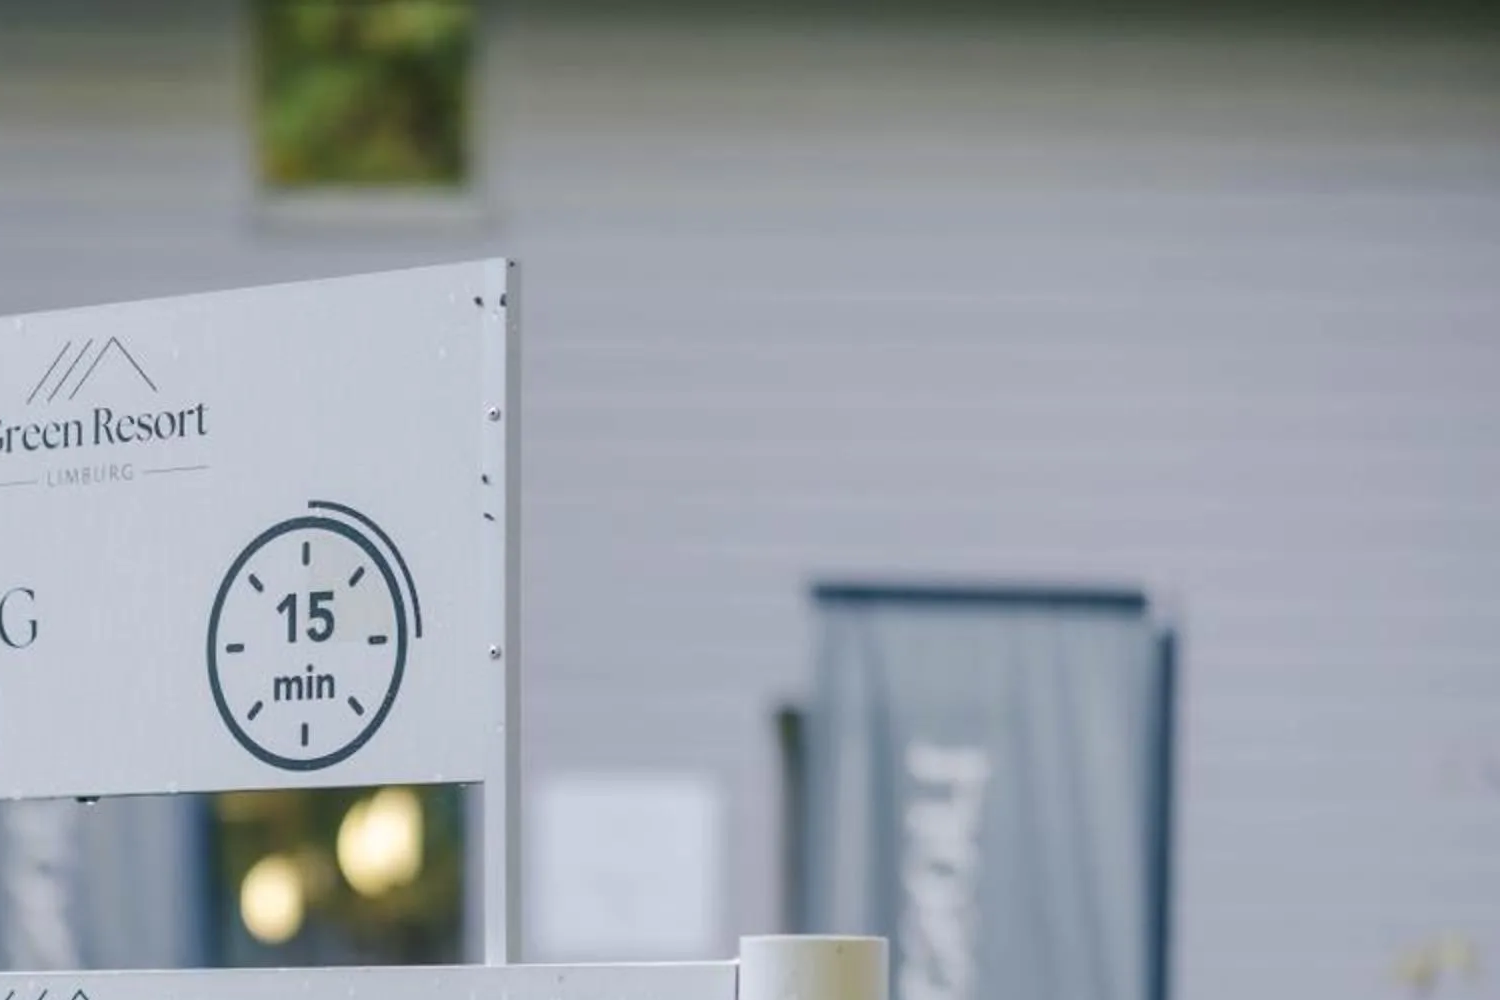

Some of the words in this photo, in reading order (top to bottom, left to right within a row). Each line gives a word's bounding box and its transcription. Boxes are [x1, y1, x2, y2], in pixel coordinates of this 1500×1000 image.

[92, 402, 209, 445] Resort
[45, 463, 136, 488] LIMBURG
[275, 589, 336, 644] 15
[273, 664, 336, 702] min
